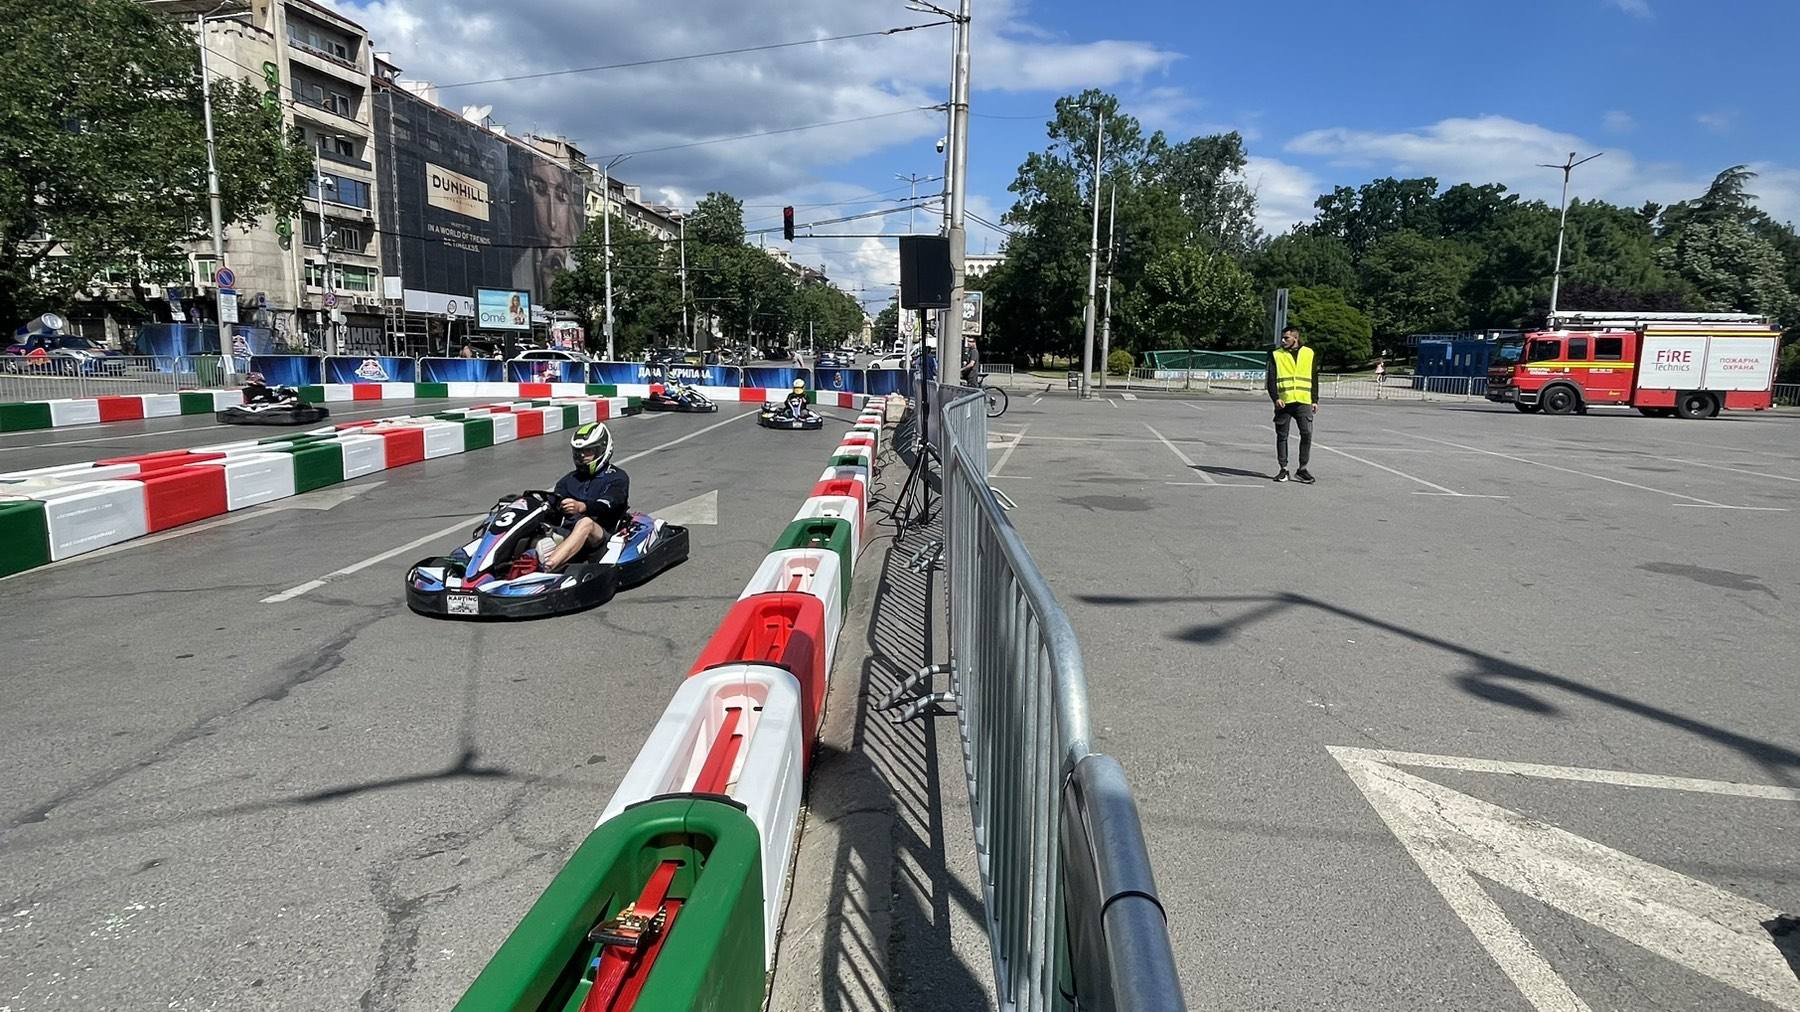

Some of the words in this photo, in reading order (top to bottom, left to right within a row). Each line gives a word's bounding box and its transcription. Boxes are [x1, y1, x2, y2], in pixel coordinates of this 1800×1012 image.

[432, 174, 484, 203] DUNHILL
[427, 223, 434, 232] IN
[435, 225, 440, 233] A
[440, 227, 462, 239] WORLD
[462, 231, 469, 240] OF
[469, 233, 491, 245] TRENDS
[480, 311, 506, 323] Omé
[1719, 356, 1759, 364] ПОЖАРНА
[1651, 362, 1690, 372] Technics
[1722, 363, 1755, 371] ОХРАНА
[494, 511, 517, 527] 3
